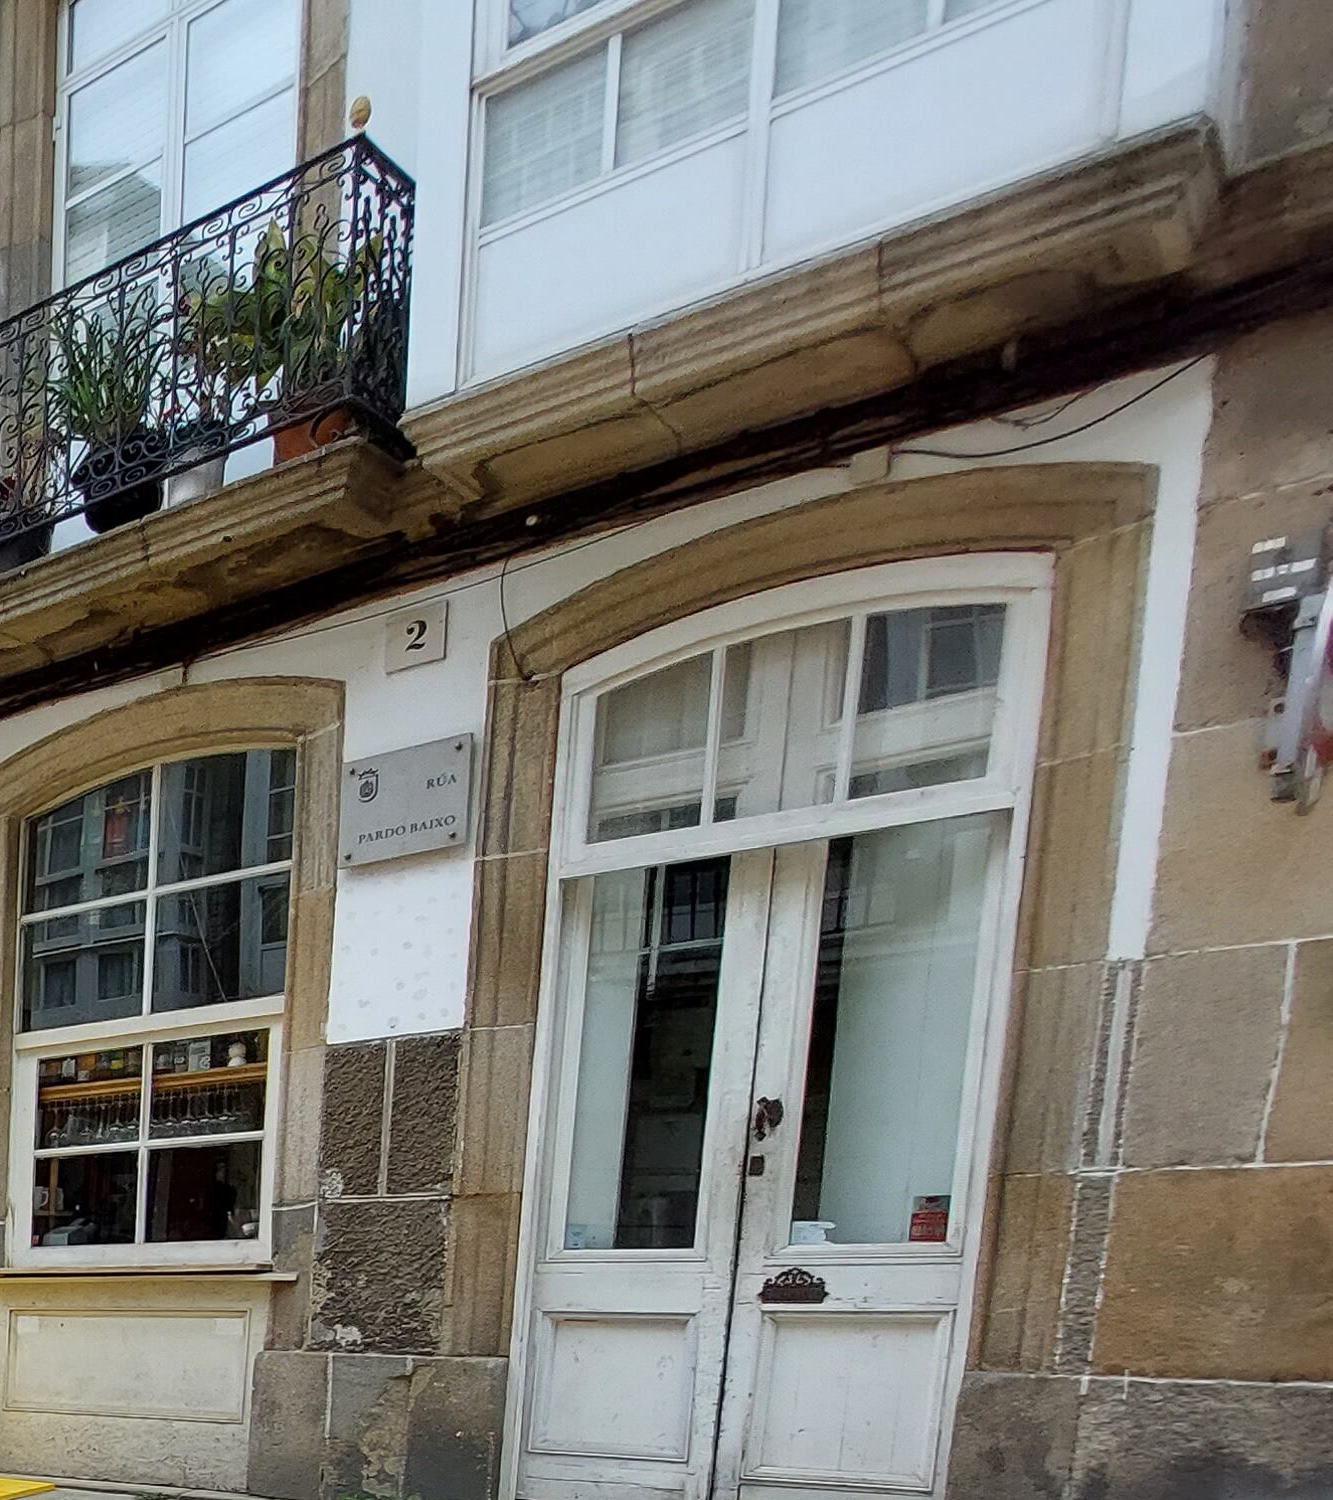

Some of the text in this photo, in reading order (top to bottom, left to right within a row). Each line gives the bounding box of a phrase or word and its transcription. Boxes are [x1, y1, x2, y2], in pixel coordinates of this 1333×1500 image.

[404, 619, 427, 652] 2
[426, 772, 457, 790] RÚA
[358, 815, 457, 844] PARDO BAIXO
